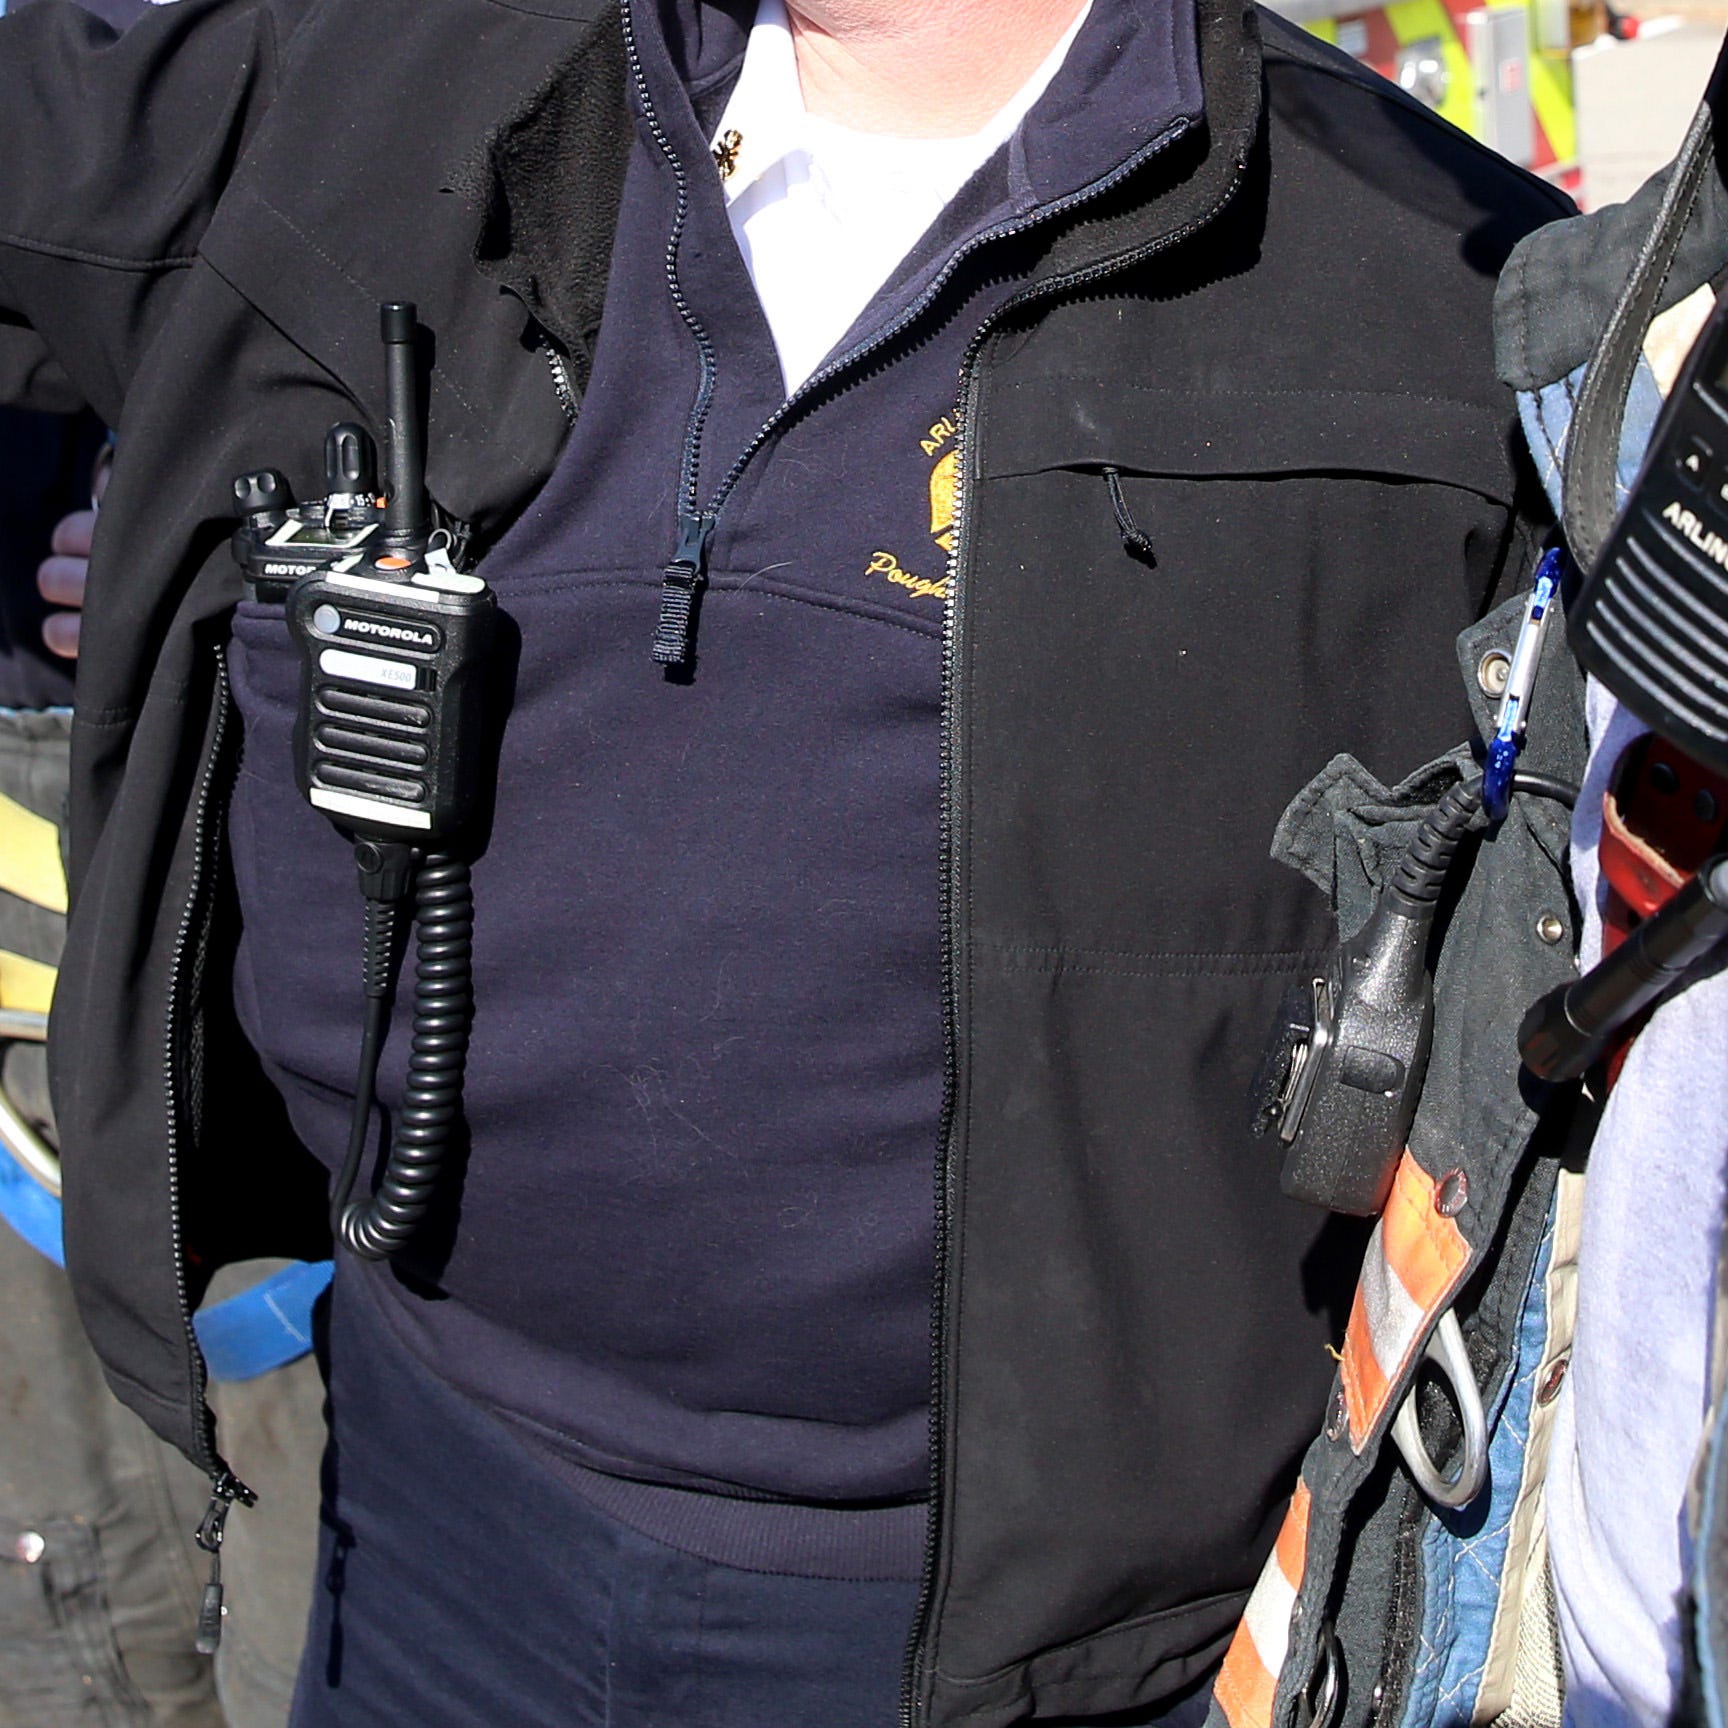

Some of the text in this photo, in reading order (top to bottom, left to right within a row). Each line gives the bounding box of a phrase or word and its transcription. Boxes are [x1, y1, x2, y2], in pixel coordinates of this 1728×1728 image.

[920, 416, 957, 457] ARL
[1685, 454, 1700, 472] A
[264, 563, 317, 576] MOTOR
[864, 551, 951, 599] Pough
[343, 618, 434, 646] MOTOROLA
[380, 667, 413, 684] XE500
